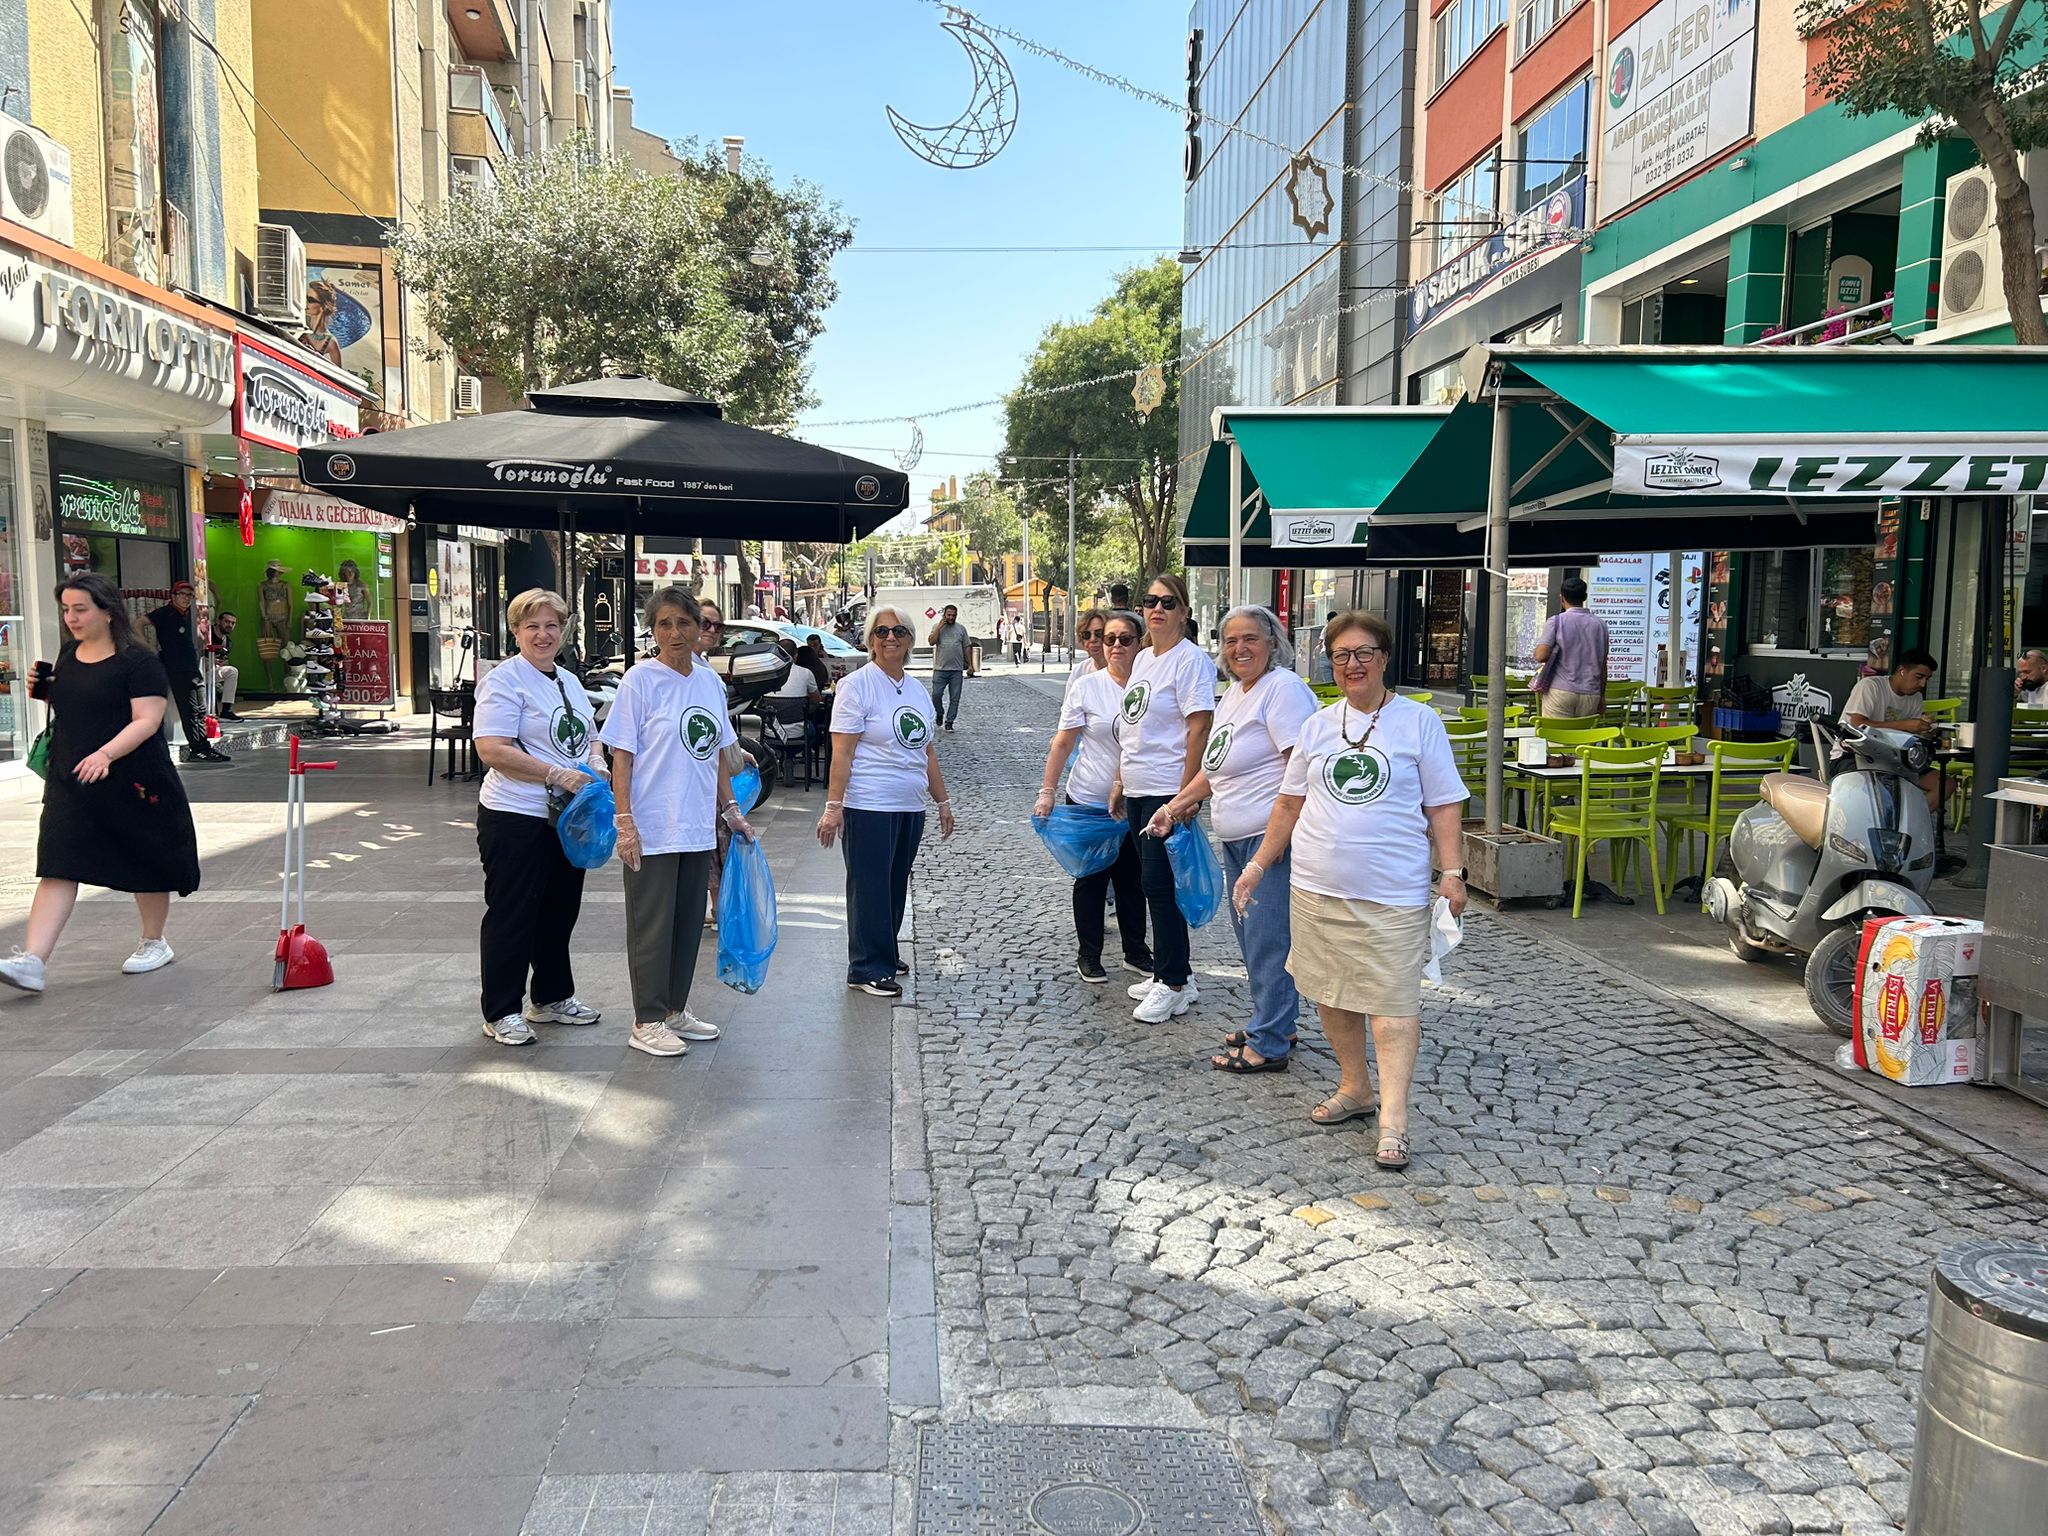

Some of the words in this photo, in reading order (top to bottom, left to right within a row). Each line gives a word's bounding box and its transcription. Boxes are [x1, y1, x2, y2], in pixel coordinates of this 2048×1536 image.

[1640, 4, 1711, 90] ZAFER
[1686, 78, 1695, 99] &
[1695, 48, 1735, 94] HUKUK
[1641, 91, 1709, 153] DANIŞMANLIK
[1677, 146, 1695, 166] 0332
[41, 272, 144, 354] FORM
[487, 459, 608, 488] Torunoğlu
[616, 477, 643, 487] Fast
[645, 478, 675, 488] Food
[718, 483, 733, 491] beri
[1650, 465, 1683, 475] LEZZET
[1684, 464, 1713, 476] DÖNER
[1748, 455, 2048, 493] LEZZET
[316, 505, 325, 522] &
[355, 637, 361, 646] 1
[345, 672, 382, 683] EDAVA
[1884, 975, 1901, 1040] ESTRELLA
[1924, 981, 1940, 1043] ESTRELLA
